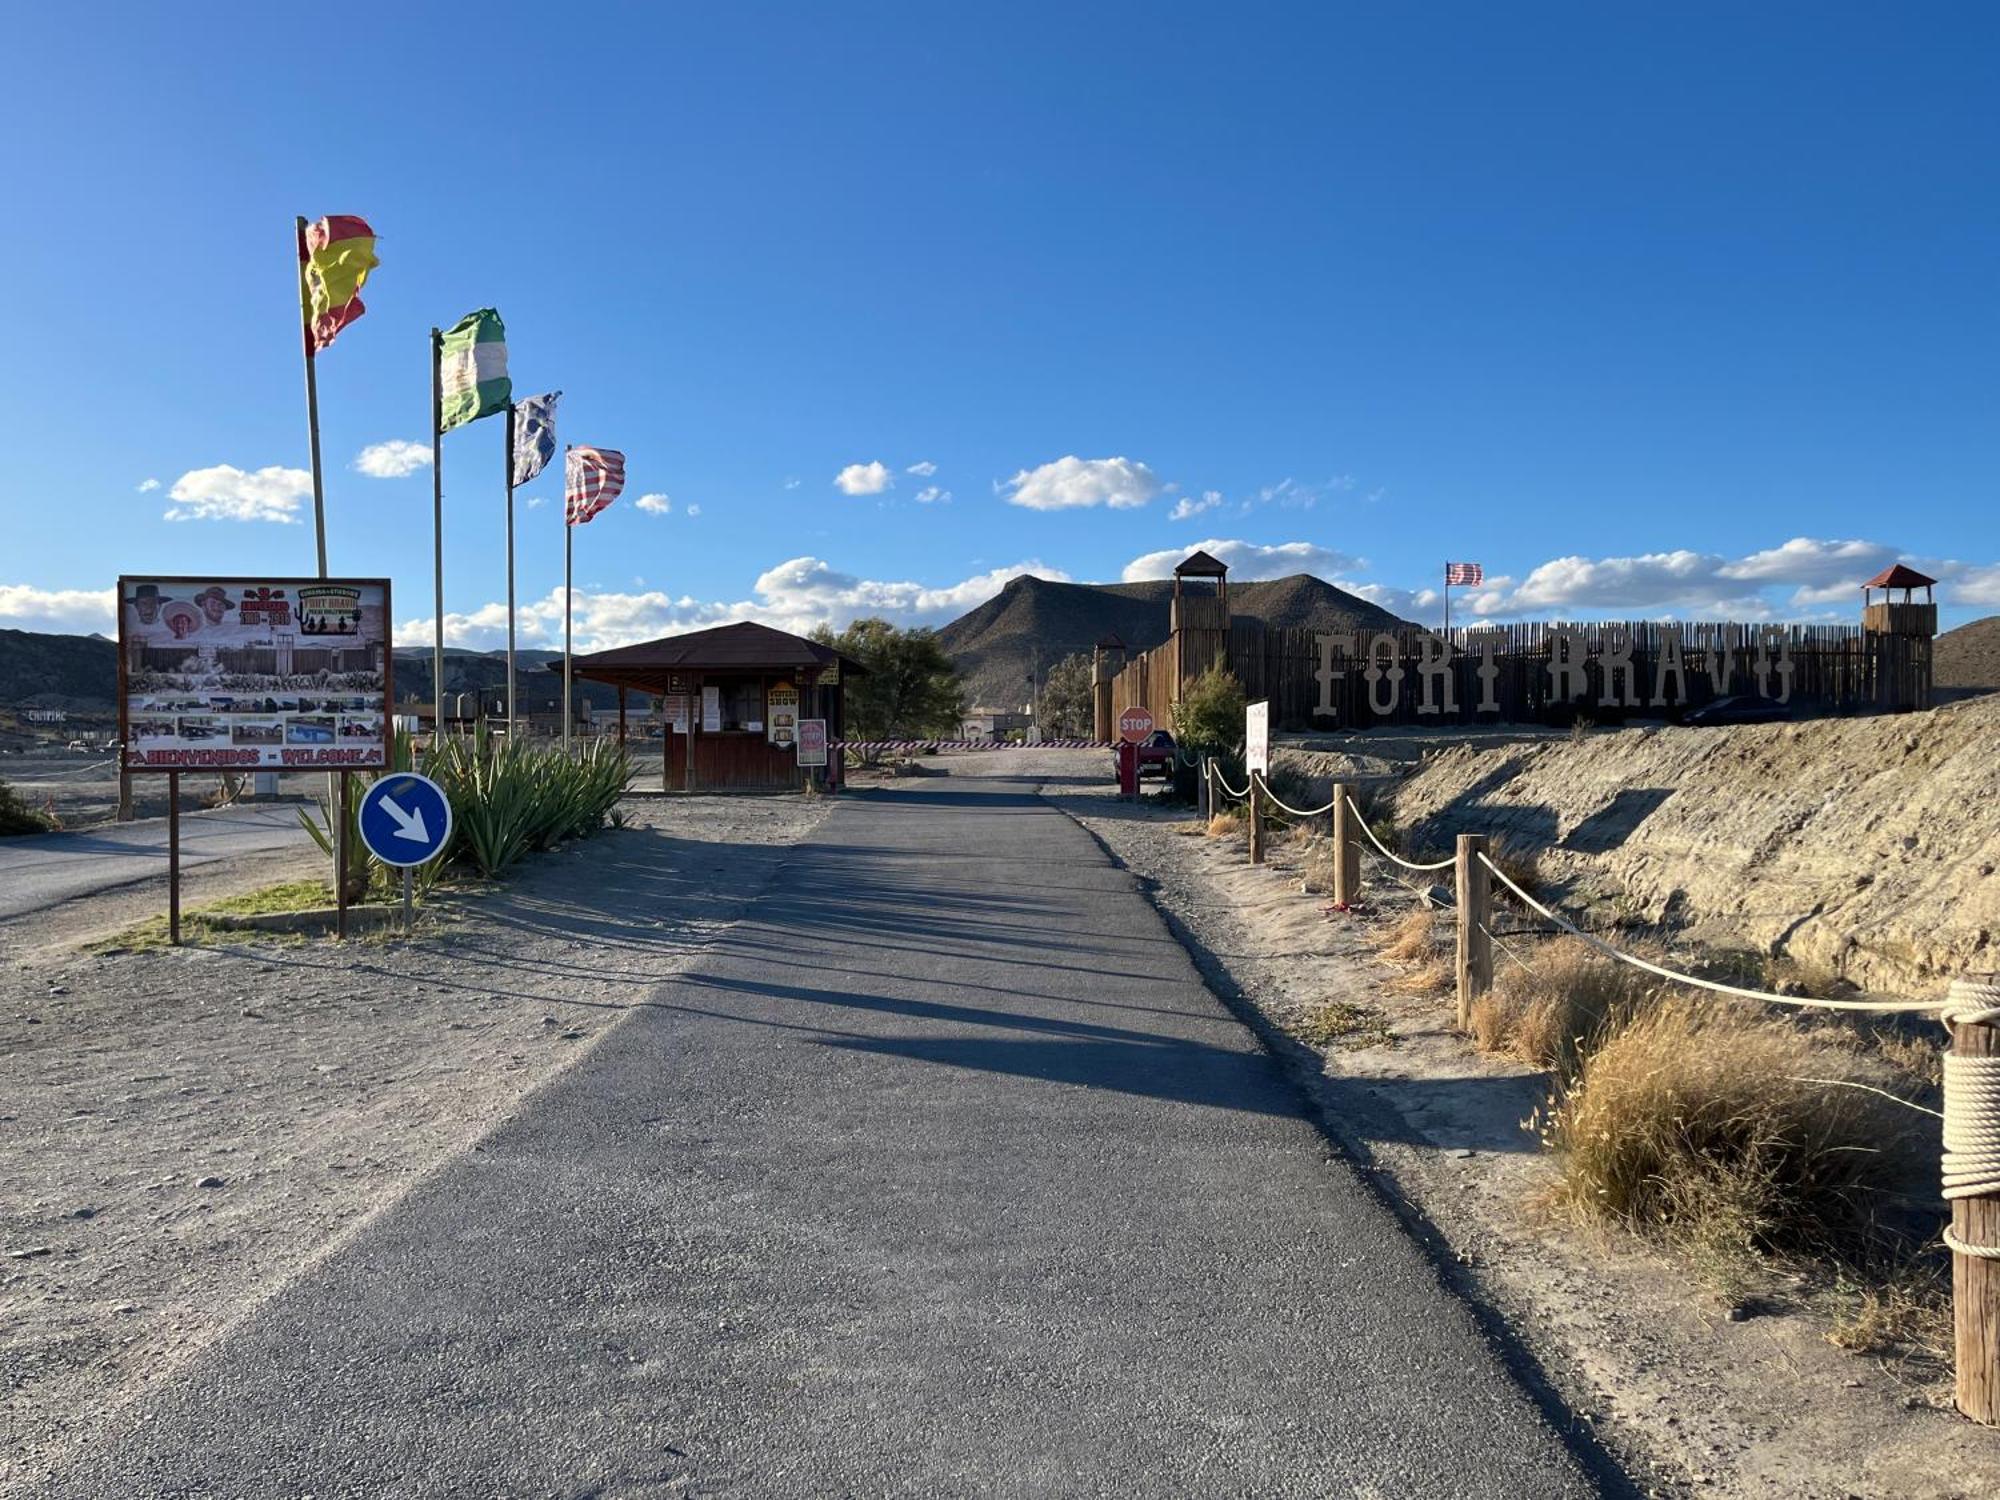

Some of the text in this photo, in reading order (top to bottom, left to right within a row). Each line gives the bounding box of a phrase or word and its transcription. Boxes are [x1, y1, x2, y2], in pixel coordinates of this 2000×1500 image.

[1313, 626, 1795, 716] FORT BRAVO
[769, 697, 798, 706] SHOW
[1121, 718, 1152, 731] STOP
[147, 749, 260, 766] BIENVENIDOS
[281, 748, 364, 765] WELCOME
